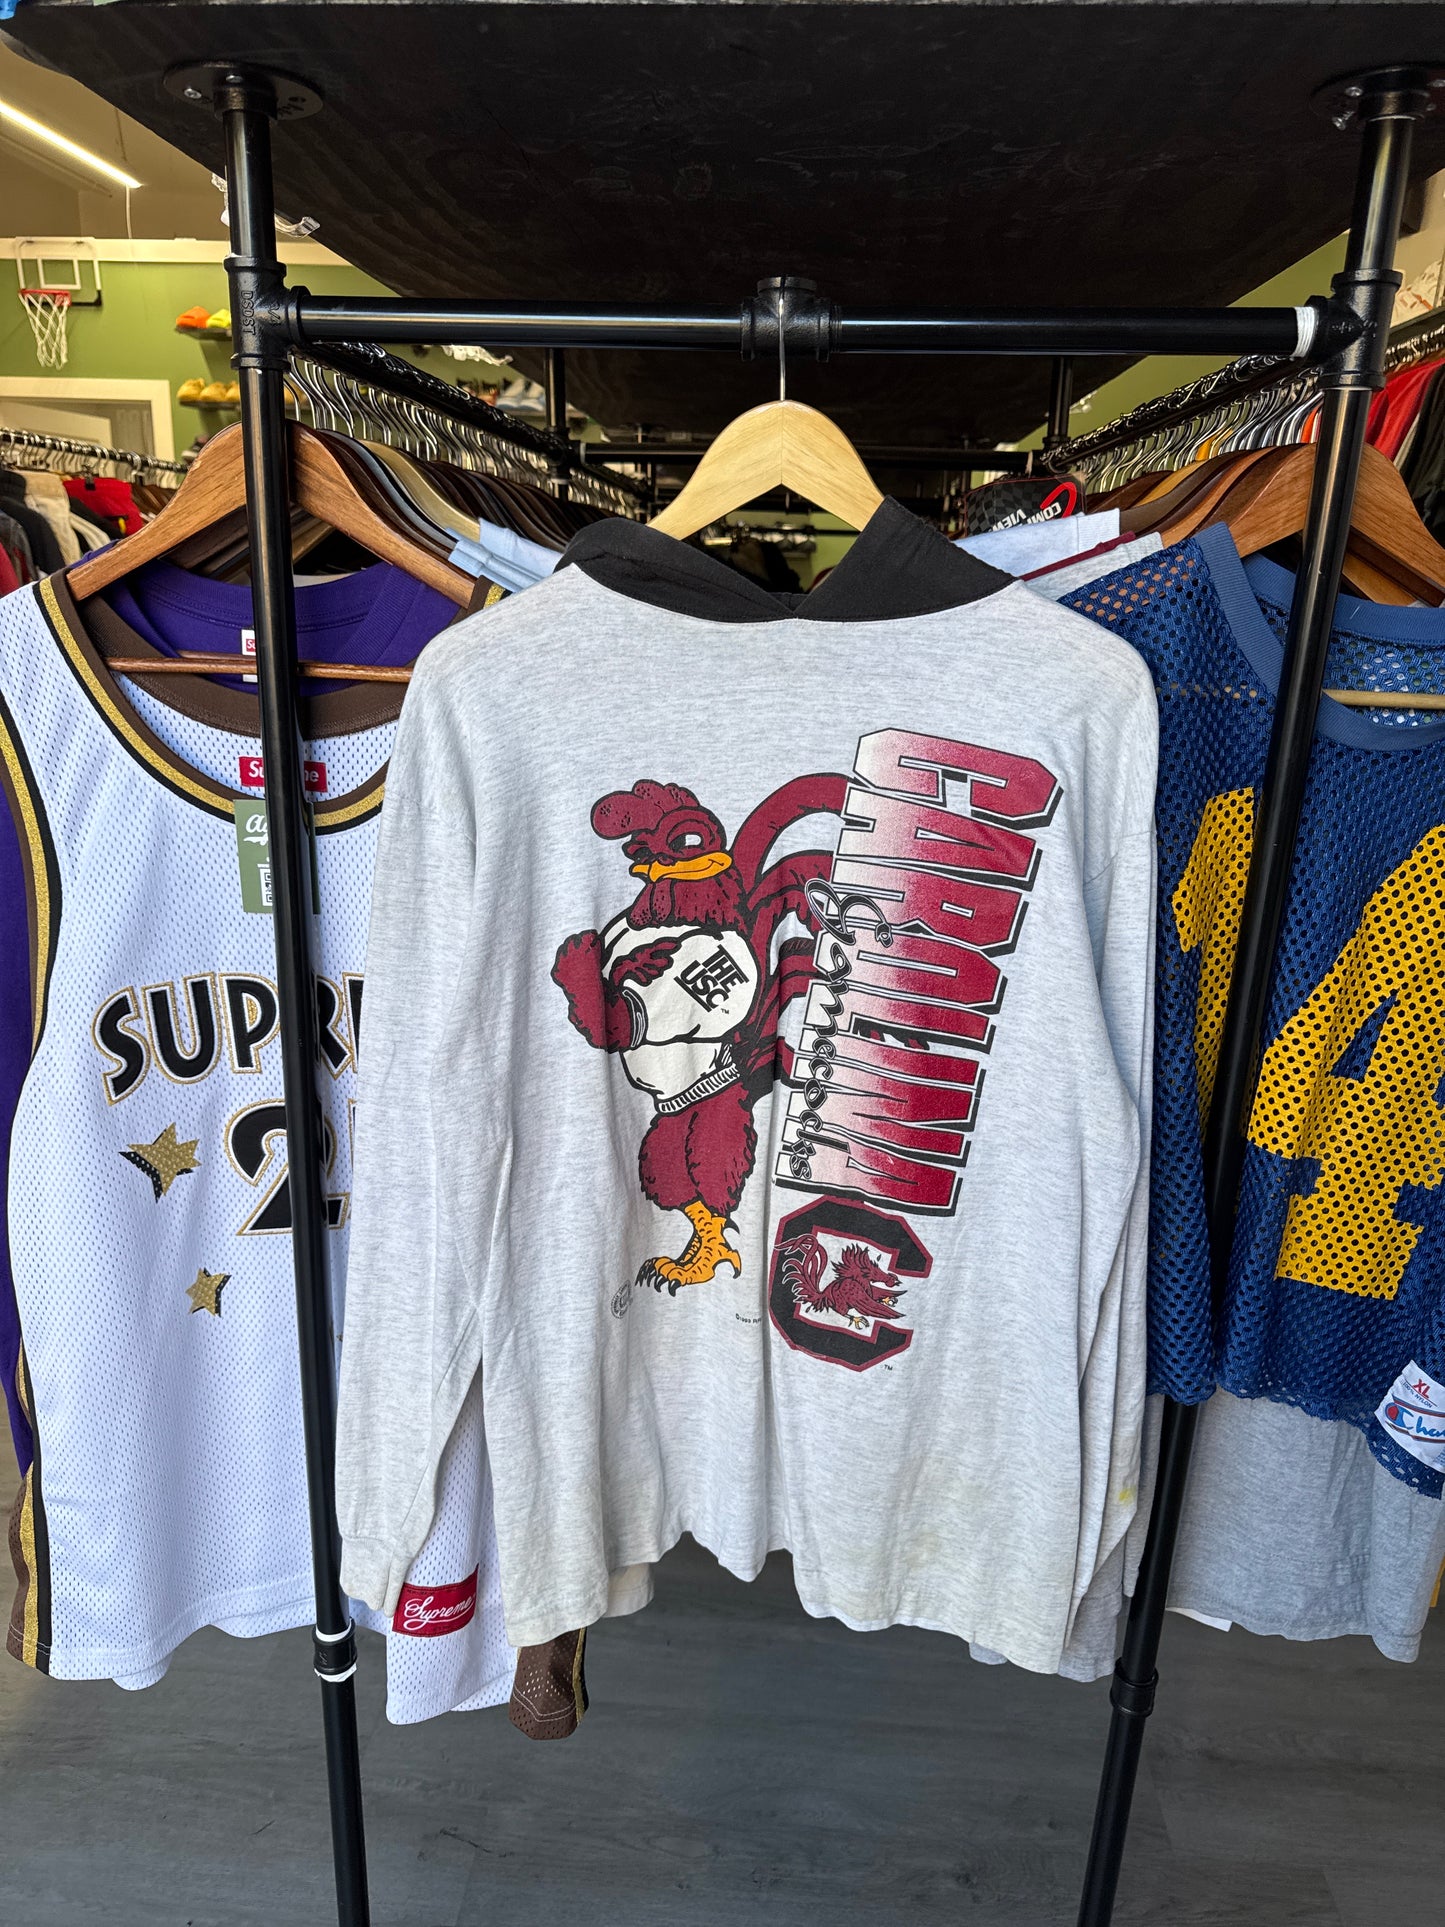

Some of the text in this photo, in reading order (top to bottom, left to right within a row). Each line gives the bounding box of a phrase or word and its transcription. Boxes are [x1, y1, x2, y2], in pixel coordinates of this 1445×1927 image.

[680, 960, 730, 1009] USC
[702, 944, 750, 993] THE
[775, 727, 1064, 1217] CAROLINA
[91, 971, 364, 1106] SUPR
[789, 878, 893, 1181] Gamecocks
[1412, 1379, 1431, 1399] XL
[1415, 1394, 1433, 1409] NYLON
[403, 1596, 475, 1631] Supreme
